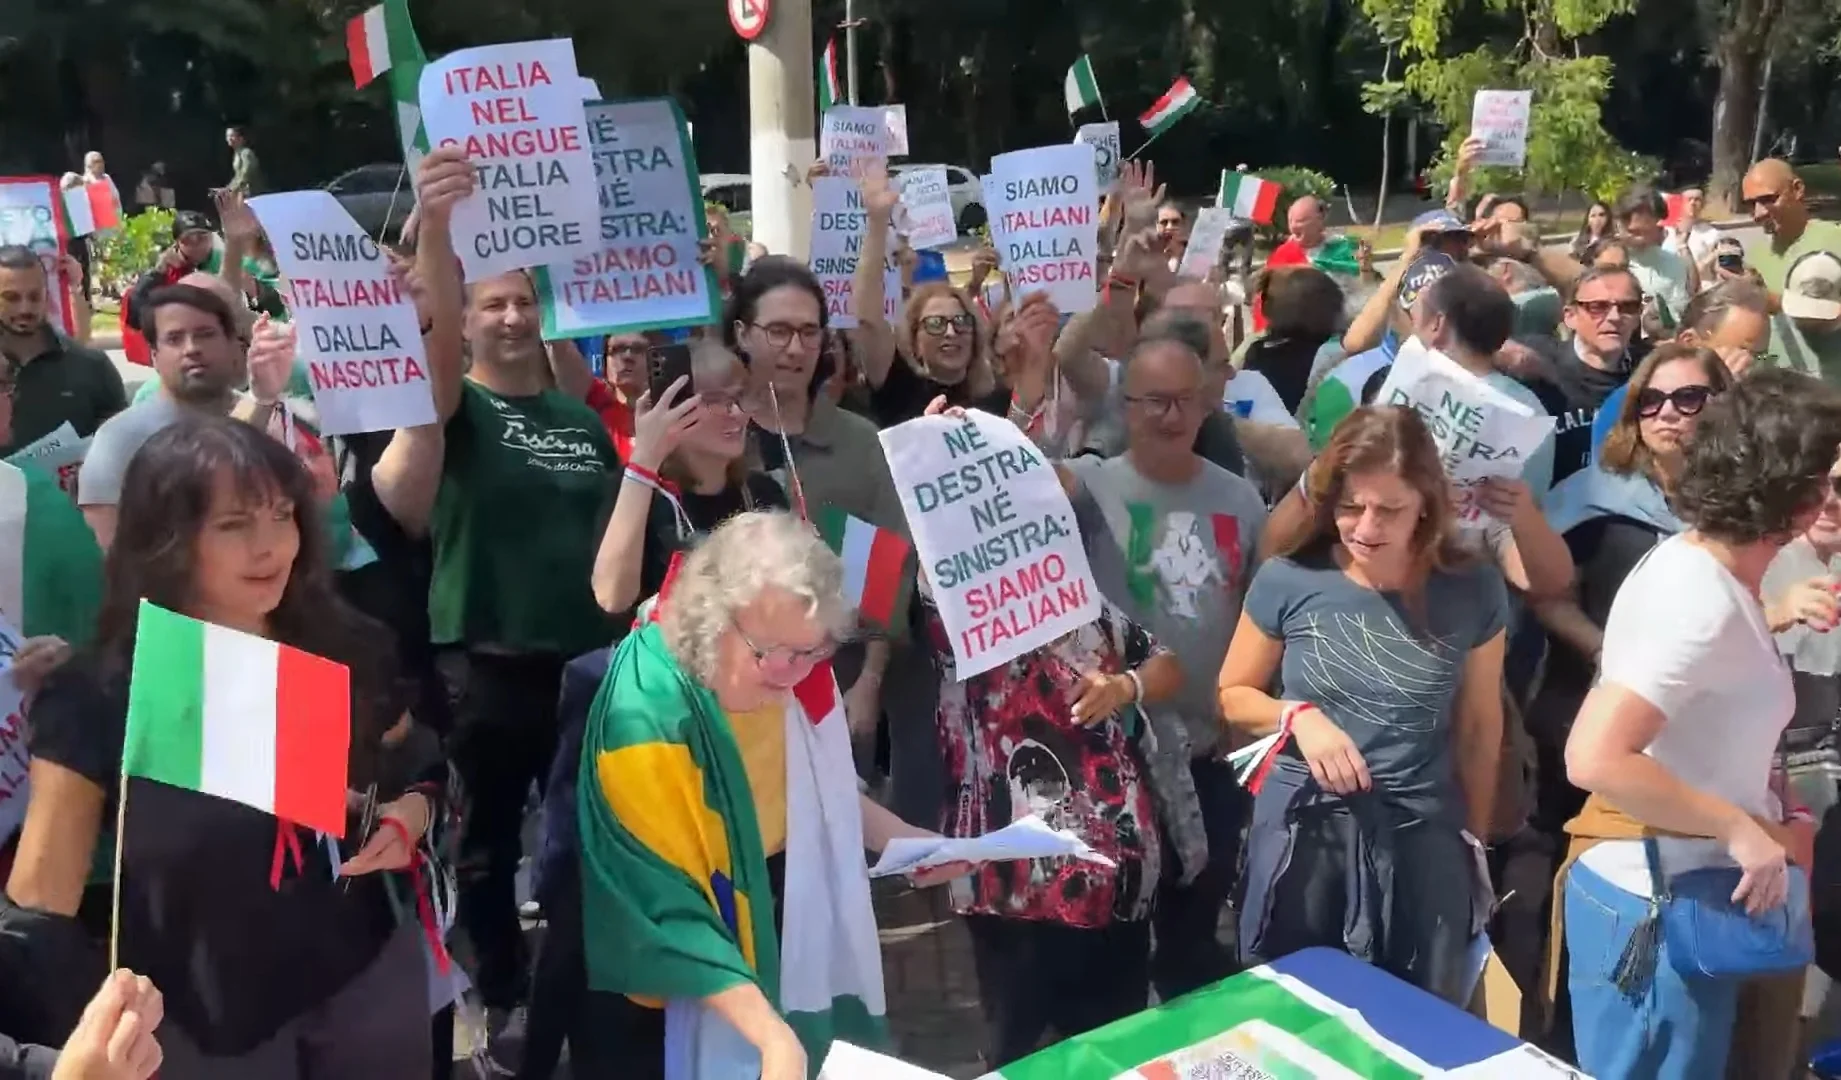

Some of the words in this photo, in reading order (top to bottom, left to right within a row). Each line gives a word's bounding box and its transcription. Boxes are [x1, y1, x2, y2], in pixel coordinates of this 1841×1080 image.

[445, 60, 552, 95] ITALIA
[470, 97, 539, 126] NEL
[832, 120, 876, 135] SIAMO
[829, 137, 880, 152] TALIANI
[475, 159, 570, 190] TALIA
[592, 146, 674, 177] STRA
[1005, 175, 1078, 200] SIAMO
[487, 194, 554, 222] NEL
[820, 212, 897, 231] DESTA
[1001, 205, 1090, 234] ITALIANI
[474, 222, 582, 259] CUORE
[601, 210, 687, 240] STRA:
[291, 231, 379, 262] SIAMO
[573, 242, 676, 276] SIAMO
[1010, 237, 1082, 262] DALLA
[289, 279, 403, 308] ITALIANI
[563, 270, 697, 307] ITALIANI
[312, 323, 402, 352] DALLA
[310, 356, 426, 391] NASCITA
[1440, 389, 1485, 434] NÉ
[913, 444, 1040, 513] DESTRA
[969, 484, 1017, 534] NÉ
[934, 512, 1071, 589] SINISTRA:
[965, 553, 1066, 620] SIAMO
[960, 577, 1088, 659] ITALIANI
